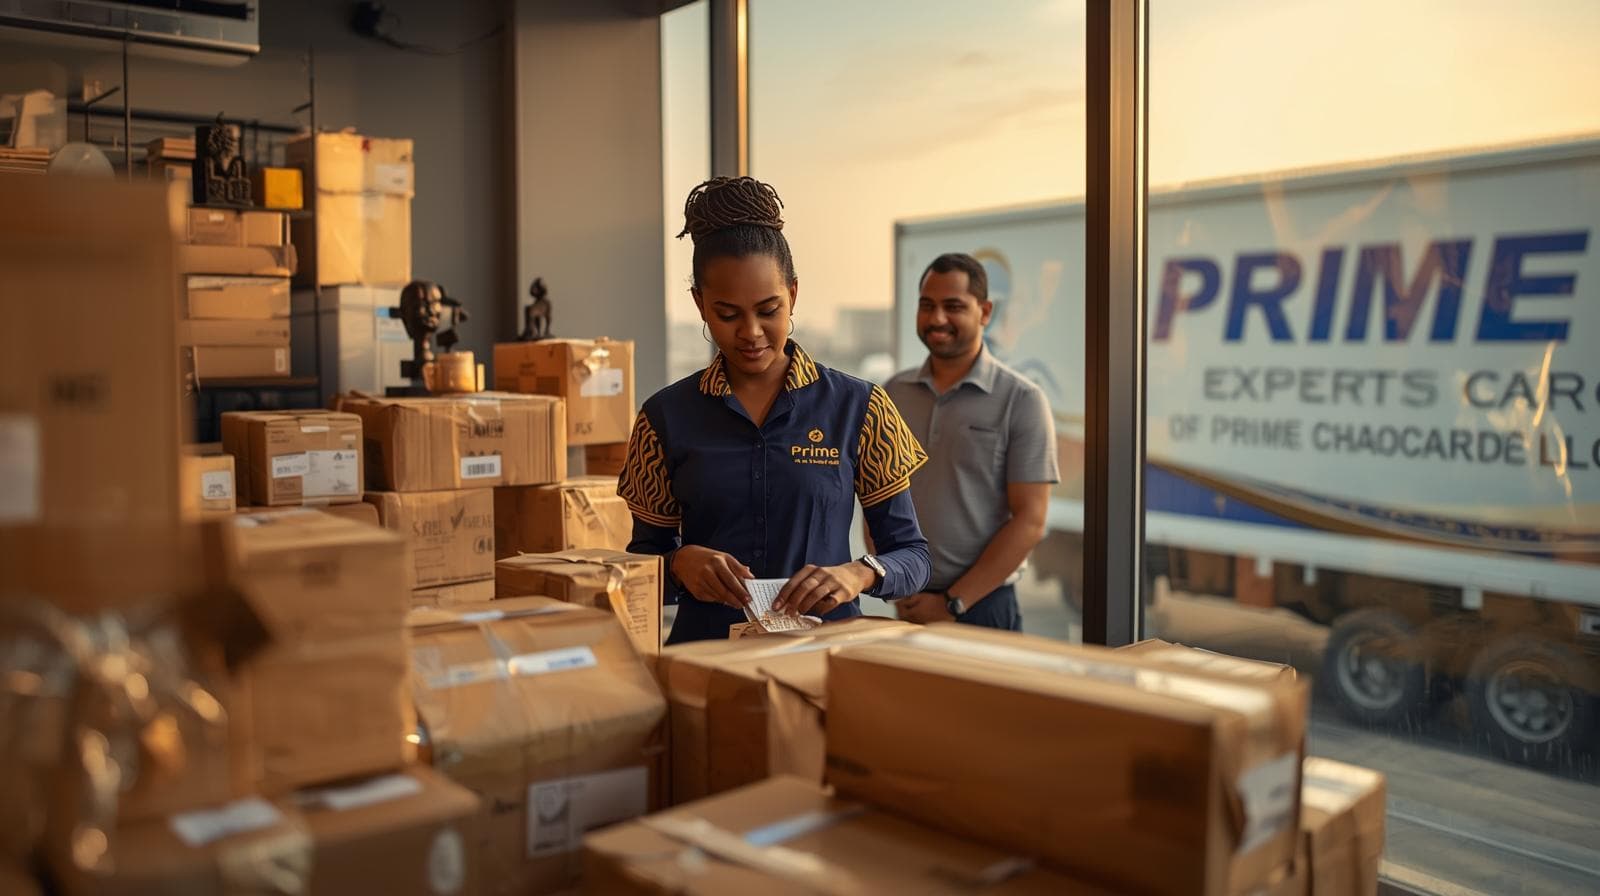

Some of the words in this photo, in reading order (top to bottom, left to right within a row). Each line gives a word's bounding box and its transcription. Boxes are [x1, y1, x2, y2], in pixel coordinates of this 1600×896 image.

[1152, 229, 1590, 342] PRIME
[1203, 367, 1439, 407] EXPERTS
[1463, 370, 1600, 412] CAR
[791, 444, 839, 457] Prime
[1211, 415, 1303, 450] PRIME
